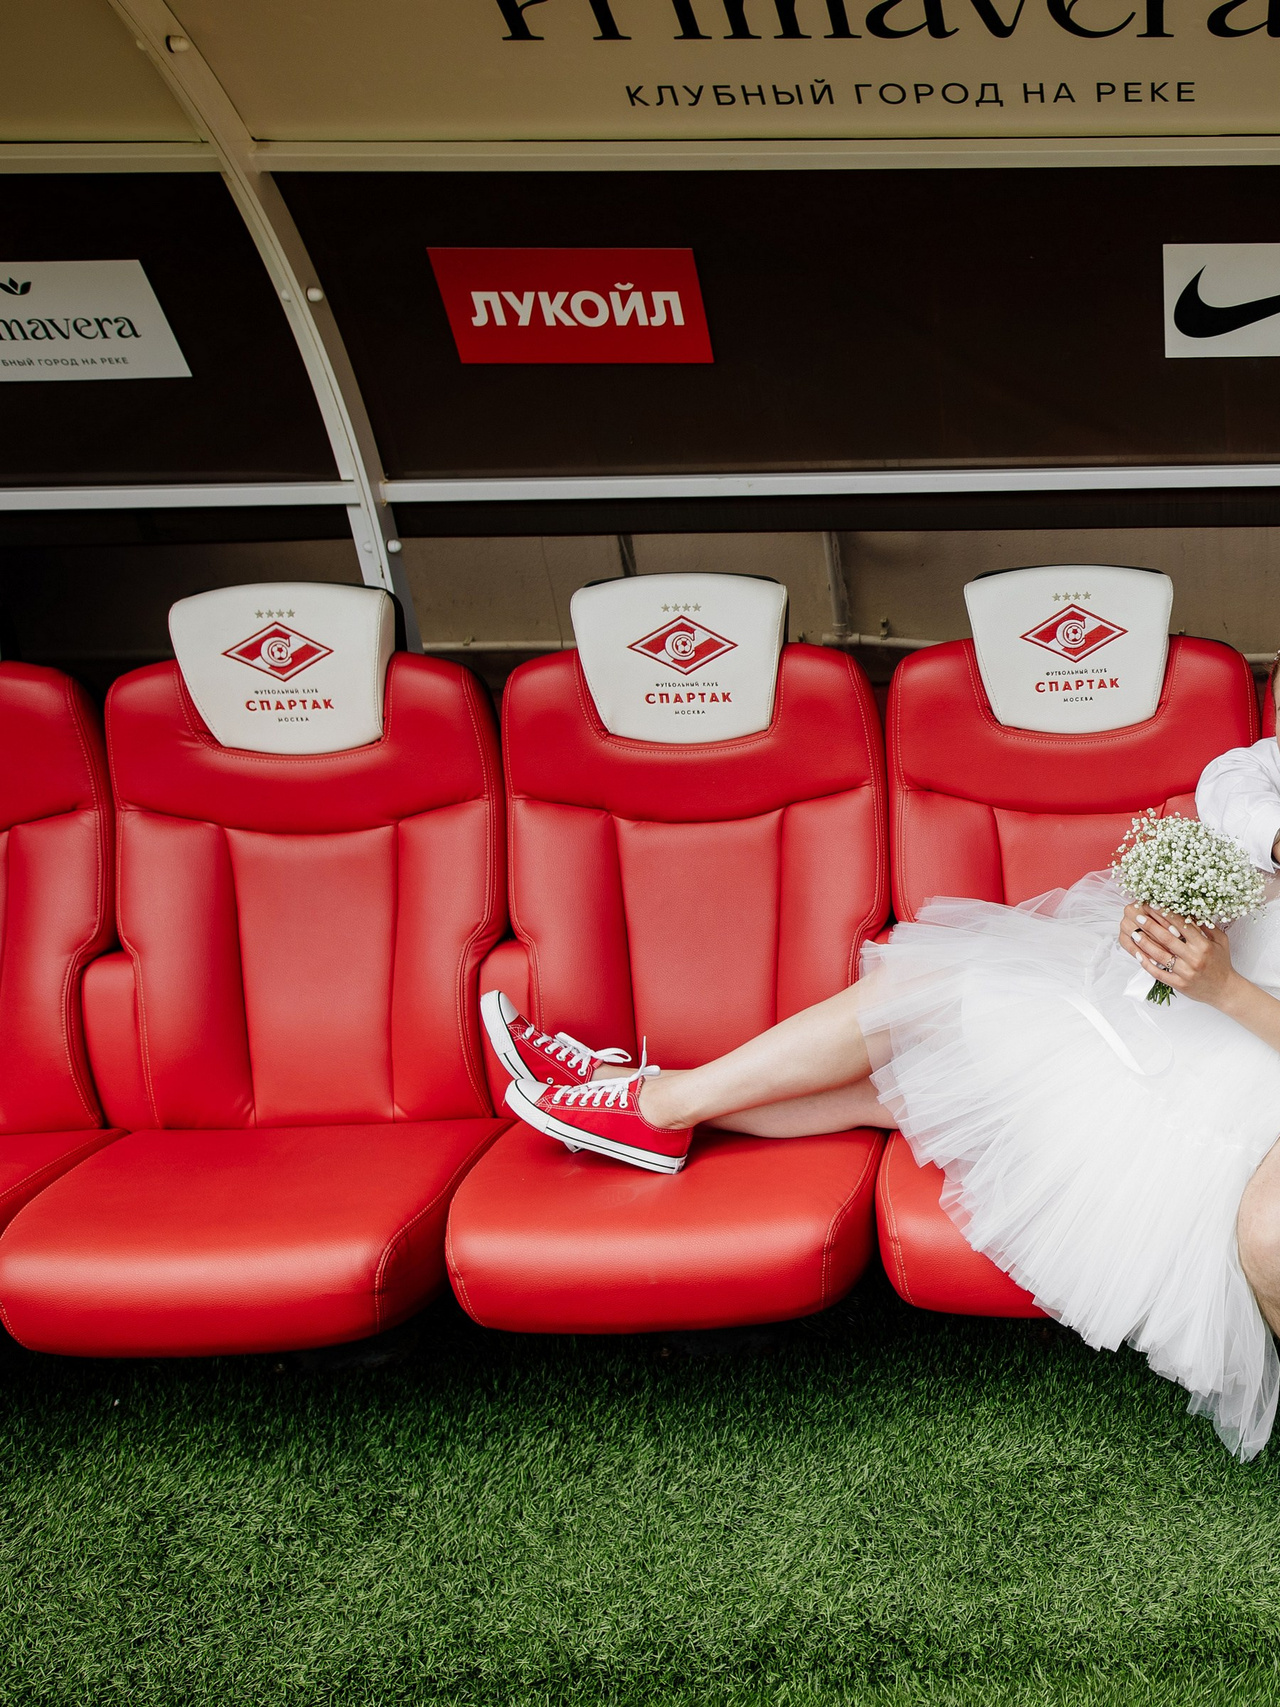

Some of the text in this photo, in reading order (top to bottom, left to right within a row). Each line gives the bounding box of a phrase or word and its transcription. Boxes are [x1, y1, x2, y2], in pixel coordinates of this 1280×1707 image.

[625, 78, 1196, 108] КЛУБНЫЙ ГОРОД НА РЕКЕ
[471, 281, 686, 328] ЛУКОЙЛ
[38, 358, 79, 367] ГОРОД
[82, 358, 98, 366] НА
[100, 356, 130, 365] РЕКЕ
[1046, 668, 1088, 676] ФУТБОЛЬНЫЙ
[1035, 678, 1120, 693] СПАРТАК
[645, 692, 732, 704] СПАРТАК
[245, 699, 334, 711] СПАРТАК
